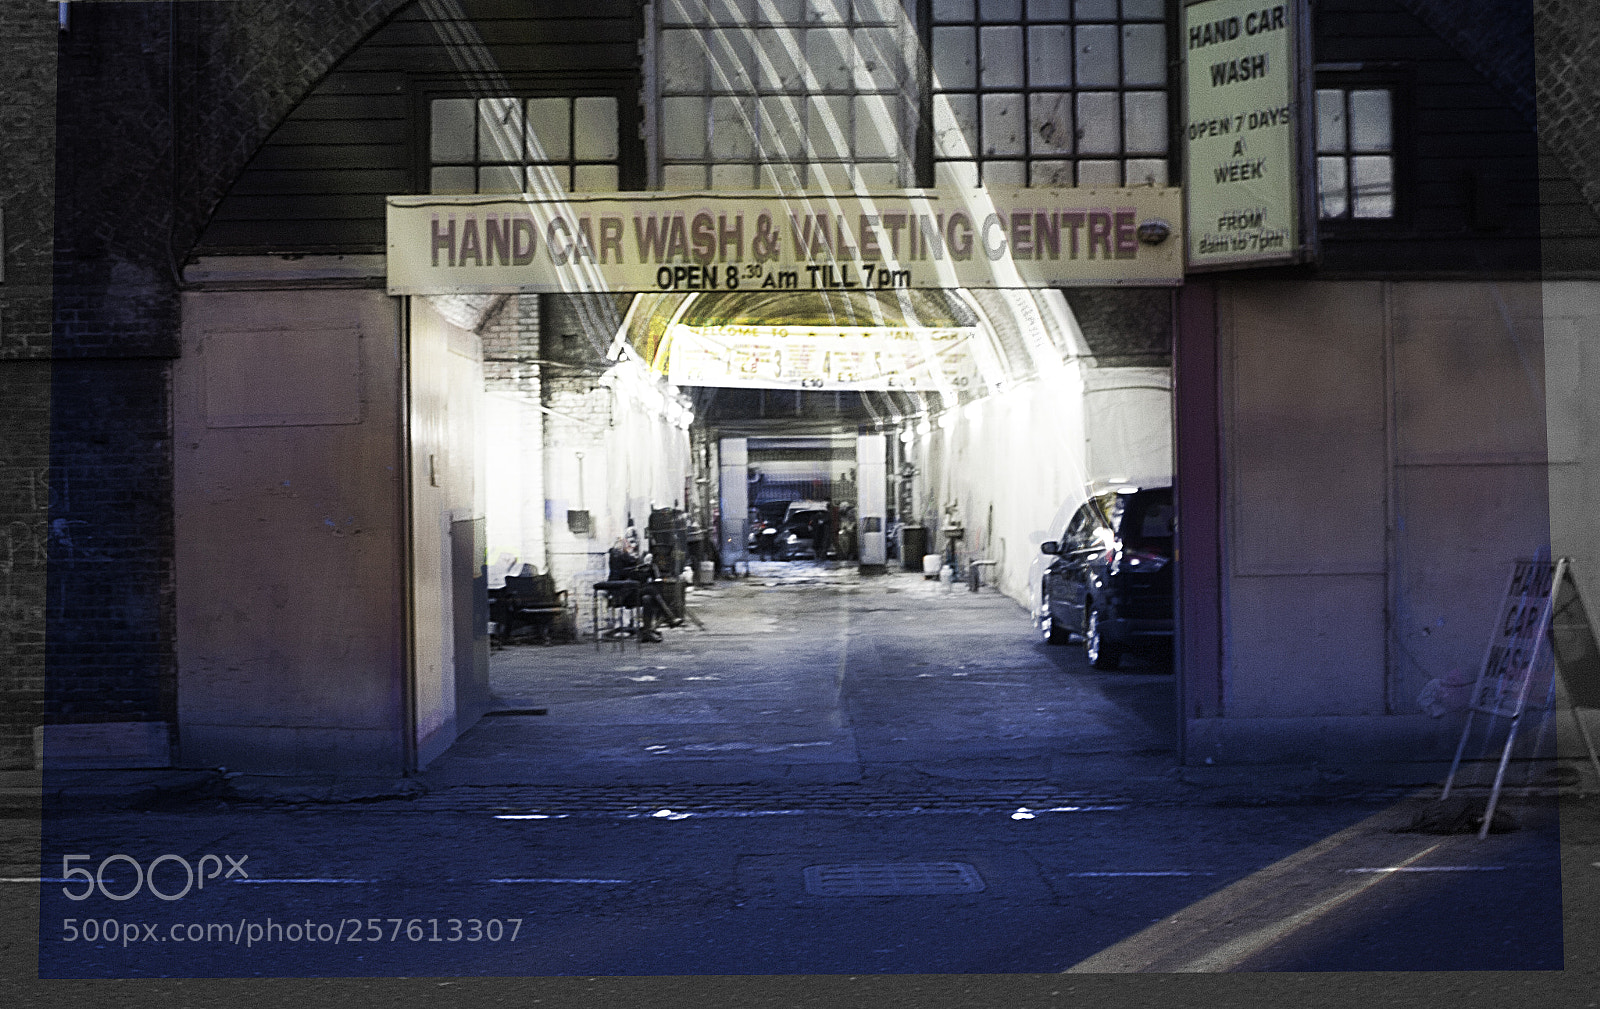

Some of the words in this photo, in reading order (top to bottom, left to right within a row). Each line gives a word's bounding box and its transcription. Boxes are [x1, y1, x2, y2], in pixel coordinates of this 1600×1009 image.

[1188, 15, 1240, 50] HAND
[1245, 5, 1286, 36] CAR
[1210, 53, 1268, 87] WASH
[1188, 116, 1232, 141] OPEN
[1235, 115, 1246, 133] 7
[1249, 106, 1291, 131] DAYS
[1232, 138, 1246, 158] A
[1213, 160, 1265, 185] WEEK
[1217, 211, 1265, 233] FROM
[431, 211, 538, 268] HAND
[546, 210, 626, 267] CAR
[632, 207, 745, 265] WASH
[752, 207, 781, 263] &
[790, 208, 974, 263] VALETING
[981, 207, 1139, 263] CENTRE
[656, 264, 718, 291] OPEN
[806, 265, 857, 288] TILL
[861, 264, 912, 290] 7pm
